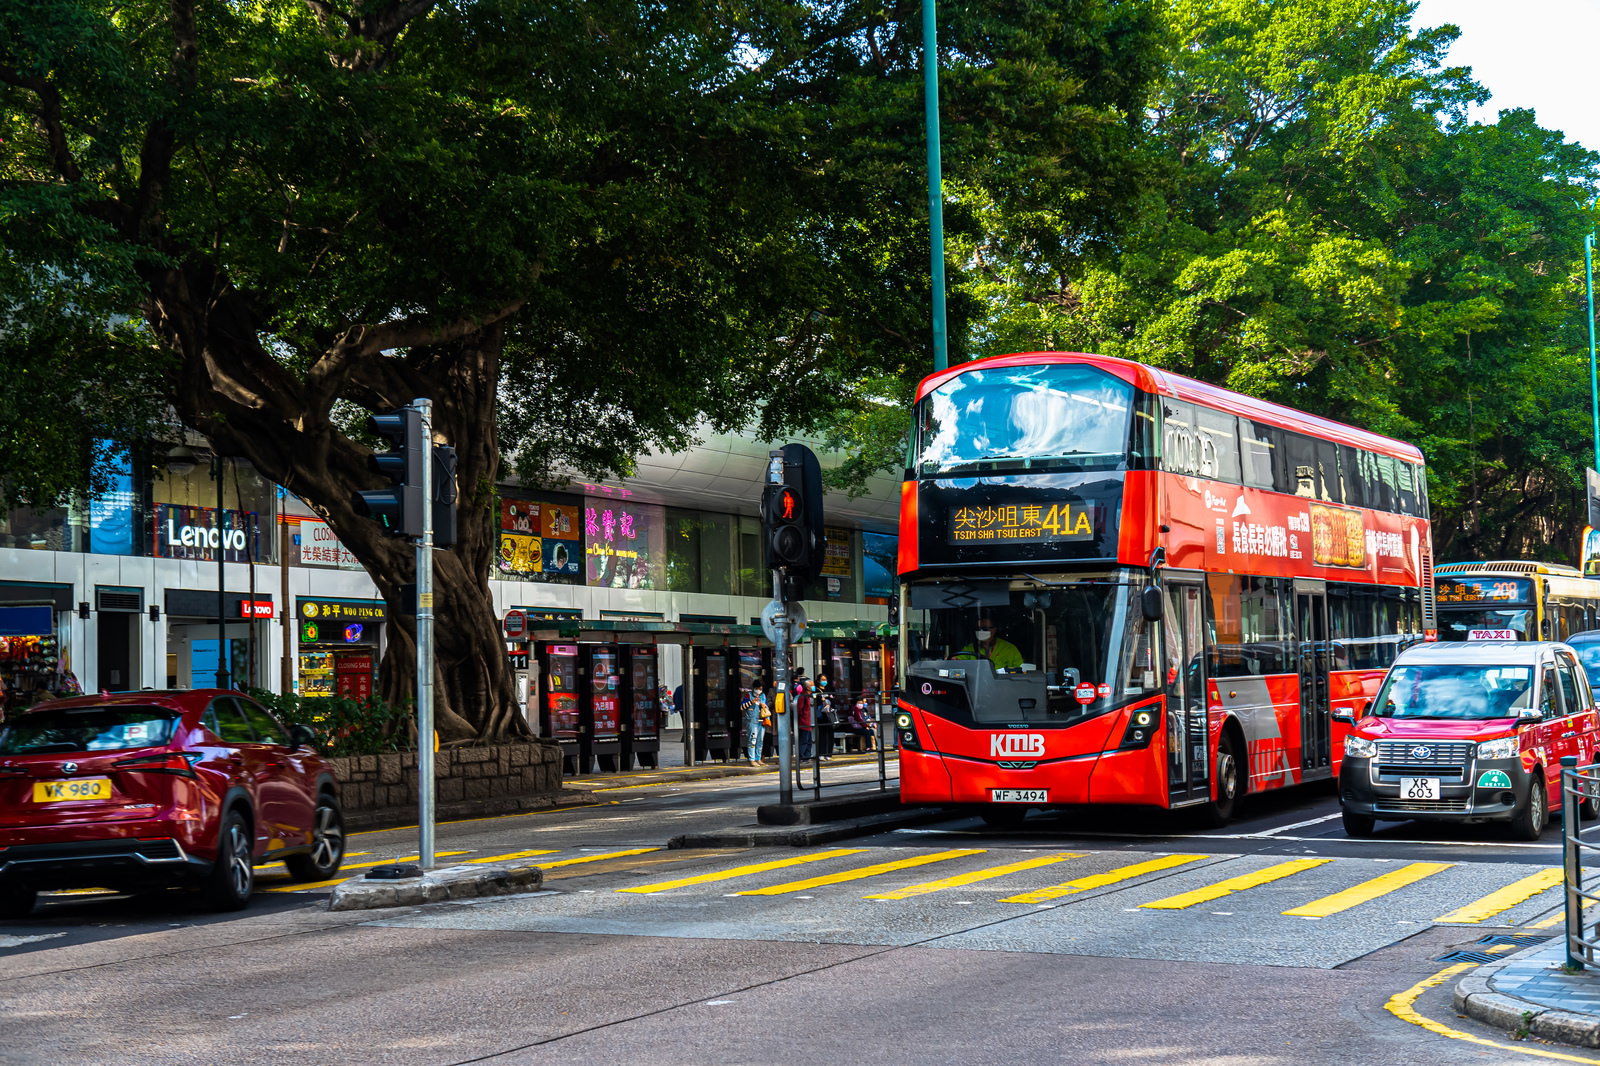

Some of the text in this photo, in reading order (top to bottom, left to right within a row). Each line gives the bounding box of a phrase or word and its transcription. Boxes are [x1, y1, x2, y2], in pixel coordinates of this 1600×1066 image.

[954, 504, 1042, 529] 尖沙咀東
[1042, 504, 1092, 535] 41A
[167, 518, 247, 551] Lenovo
[954, 527, 1042, 540] TSIM SHA TSUI EAST
[1493, 582, 1517, 600] 208
[322, 604, 341, 618] 和平
[343, 607, 385, 617] WOO PING CO.
[1472, 630, 1511, 639] TAXI
[128, 727, 141, 737] P
[990, 734, 1046, 757] KMB
[1412, 779, 1428, 788] XR
[1491, 775, 1499, 783] 4
[44, 783, 101, 797] VK 980
[994, 790, 1046, 801] WF 3494
[1408, 788, 1433, 798] 603
